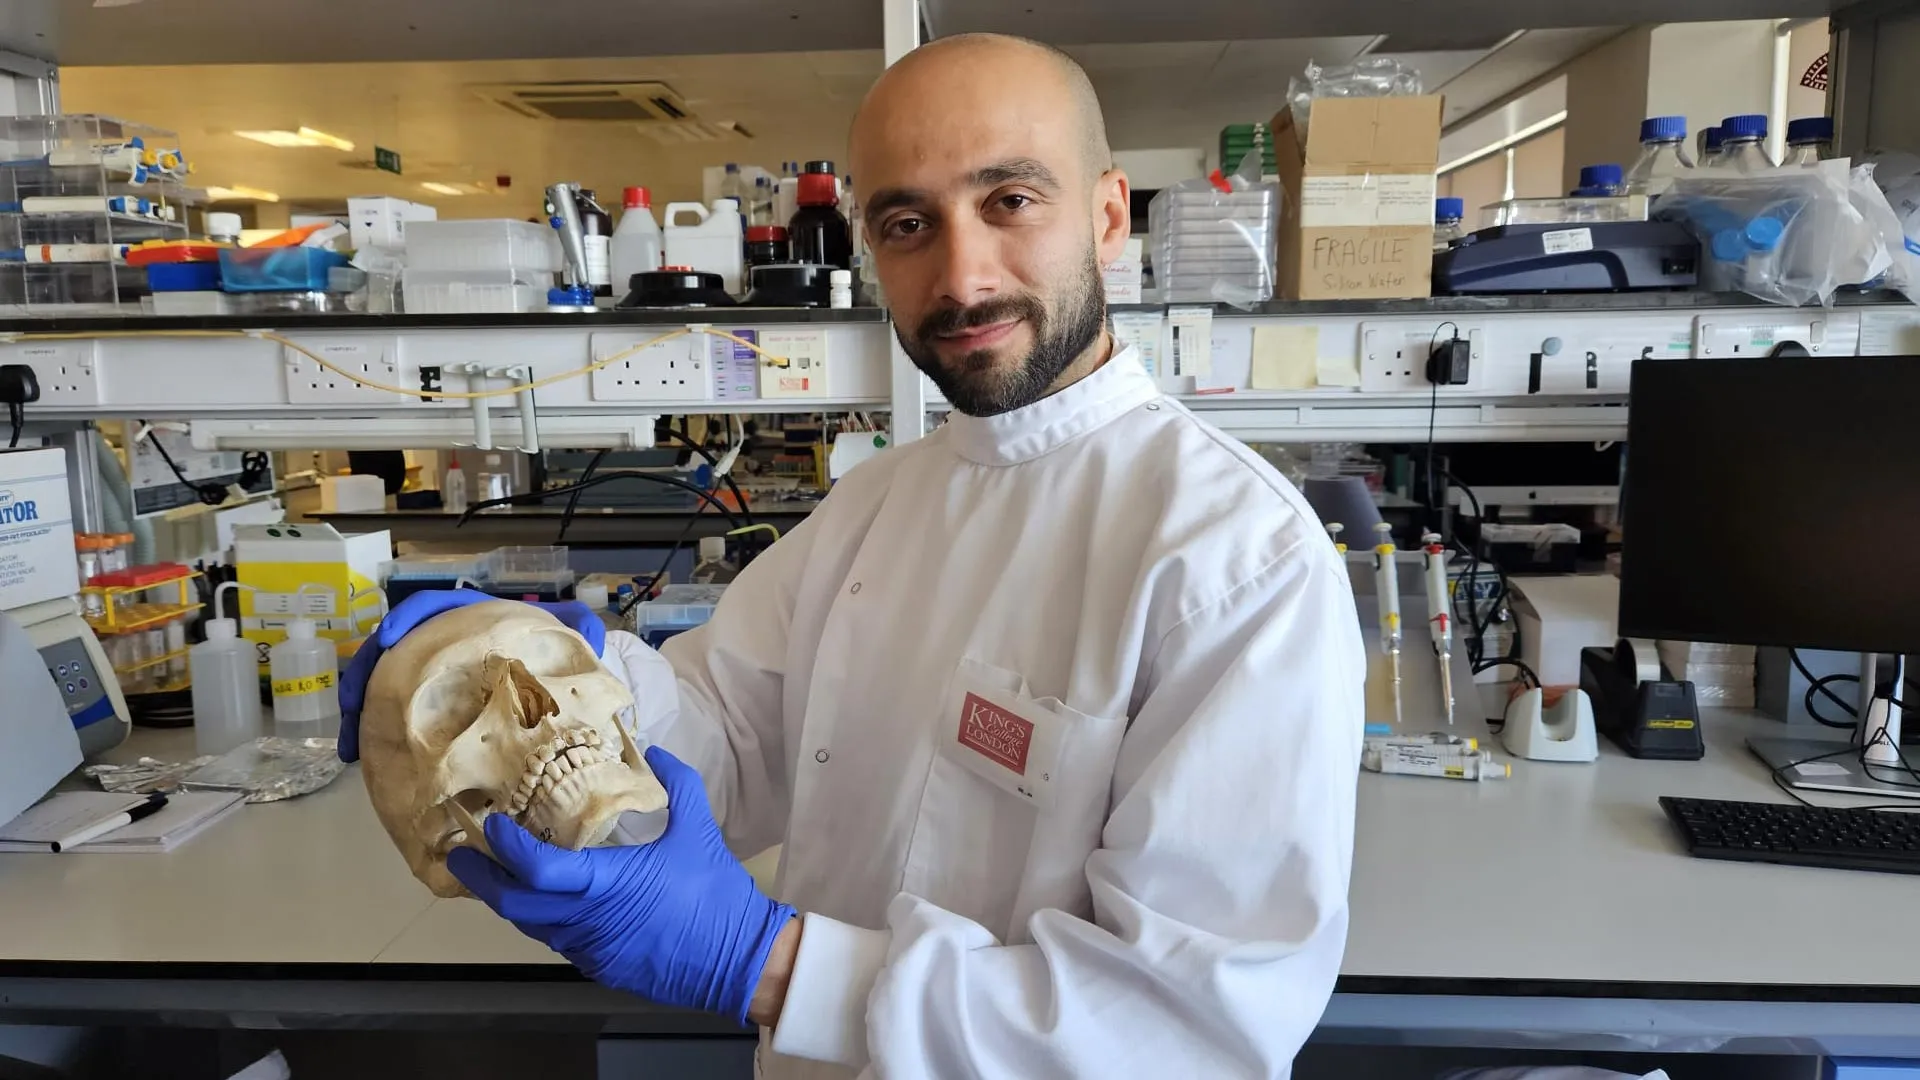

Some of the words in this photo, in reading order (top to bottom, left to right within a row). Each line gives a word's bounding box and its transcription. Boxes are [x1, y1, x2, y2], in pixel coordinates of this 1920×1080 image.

[1313, 237, 1411, 269] FRAGILE
[969, 702, 1026, 739] KING'S
[986, 723, 1024, 747] College
[966, 724, 1021, 760] LONDON
